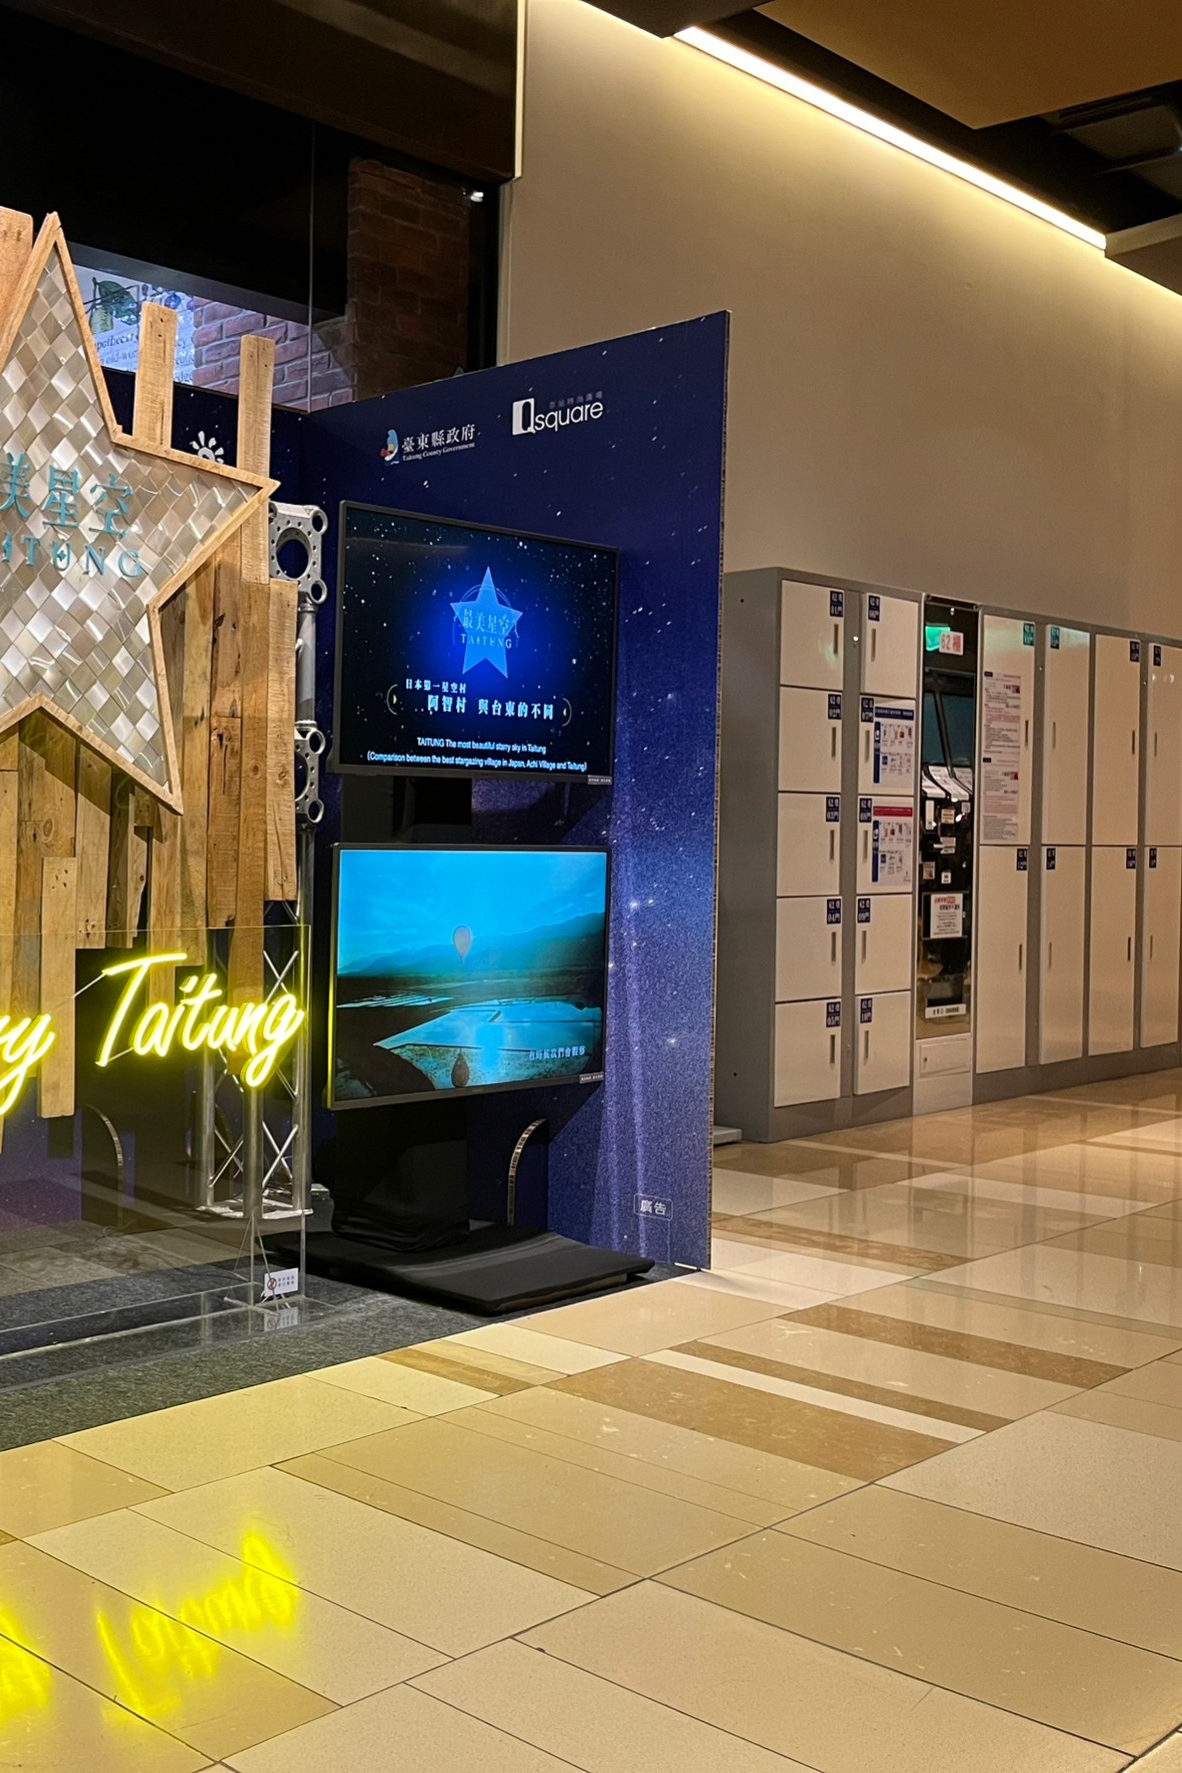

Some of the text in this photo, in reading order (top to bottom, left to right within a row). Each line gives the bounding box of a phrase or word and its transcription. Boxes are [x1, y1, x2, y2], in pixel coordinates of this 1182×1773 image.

[402, 424, 476, 453] 臺東縣政府
[442, 442, 475, 453] Government
[462, 608, 513, 635] 最美星空
[461, 634, 512, 649] TAITUNG
[406, 678, 467, 694] 日本第一星空村
[428, 694, 554, 720] 阿智村 與台東的不同
[417, 737, 546, 754] TAITUNG The most beautiful starry sky in Taitung
[406, 754, 431, 763] between
[432, 755, 441, 764] the
[442, 756, 454, 765] best
[455, 756, 483, 768] stargazing
[484, 758, 501, 768] village
[502, 759, 507, 767] in
[526, 760, 538, 768] Achi
[539, 760, 555, 771] Village
[556, 761, 566, 770] and
[95, 952, 305, 1089] Taitung
[639, 1199, 667, 1216] 廣告
